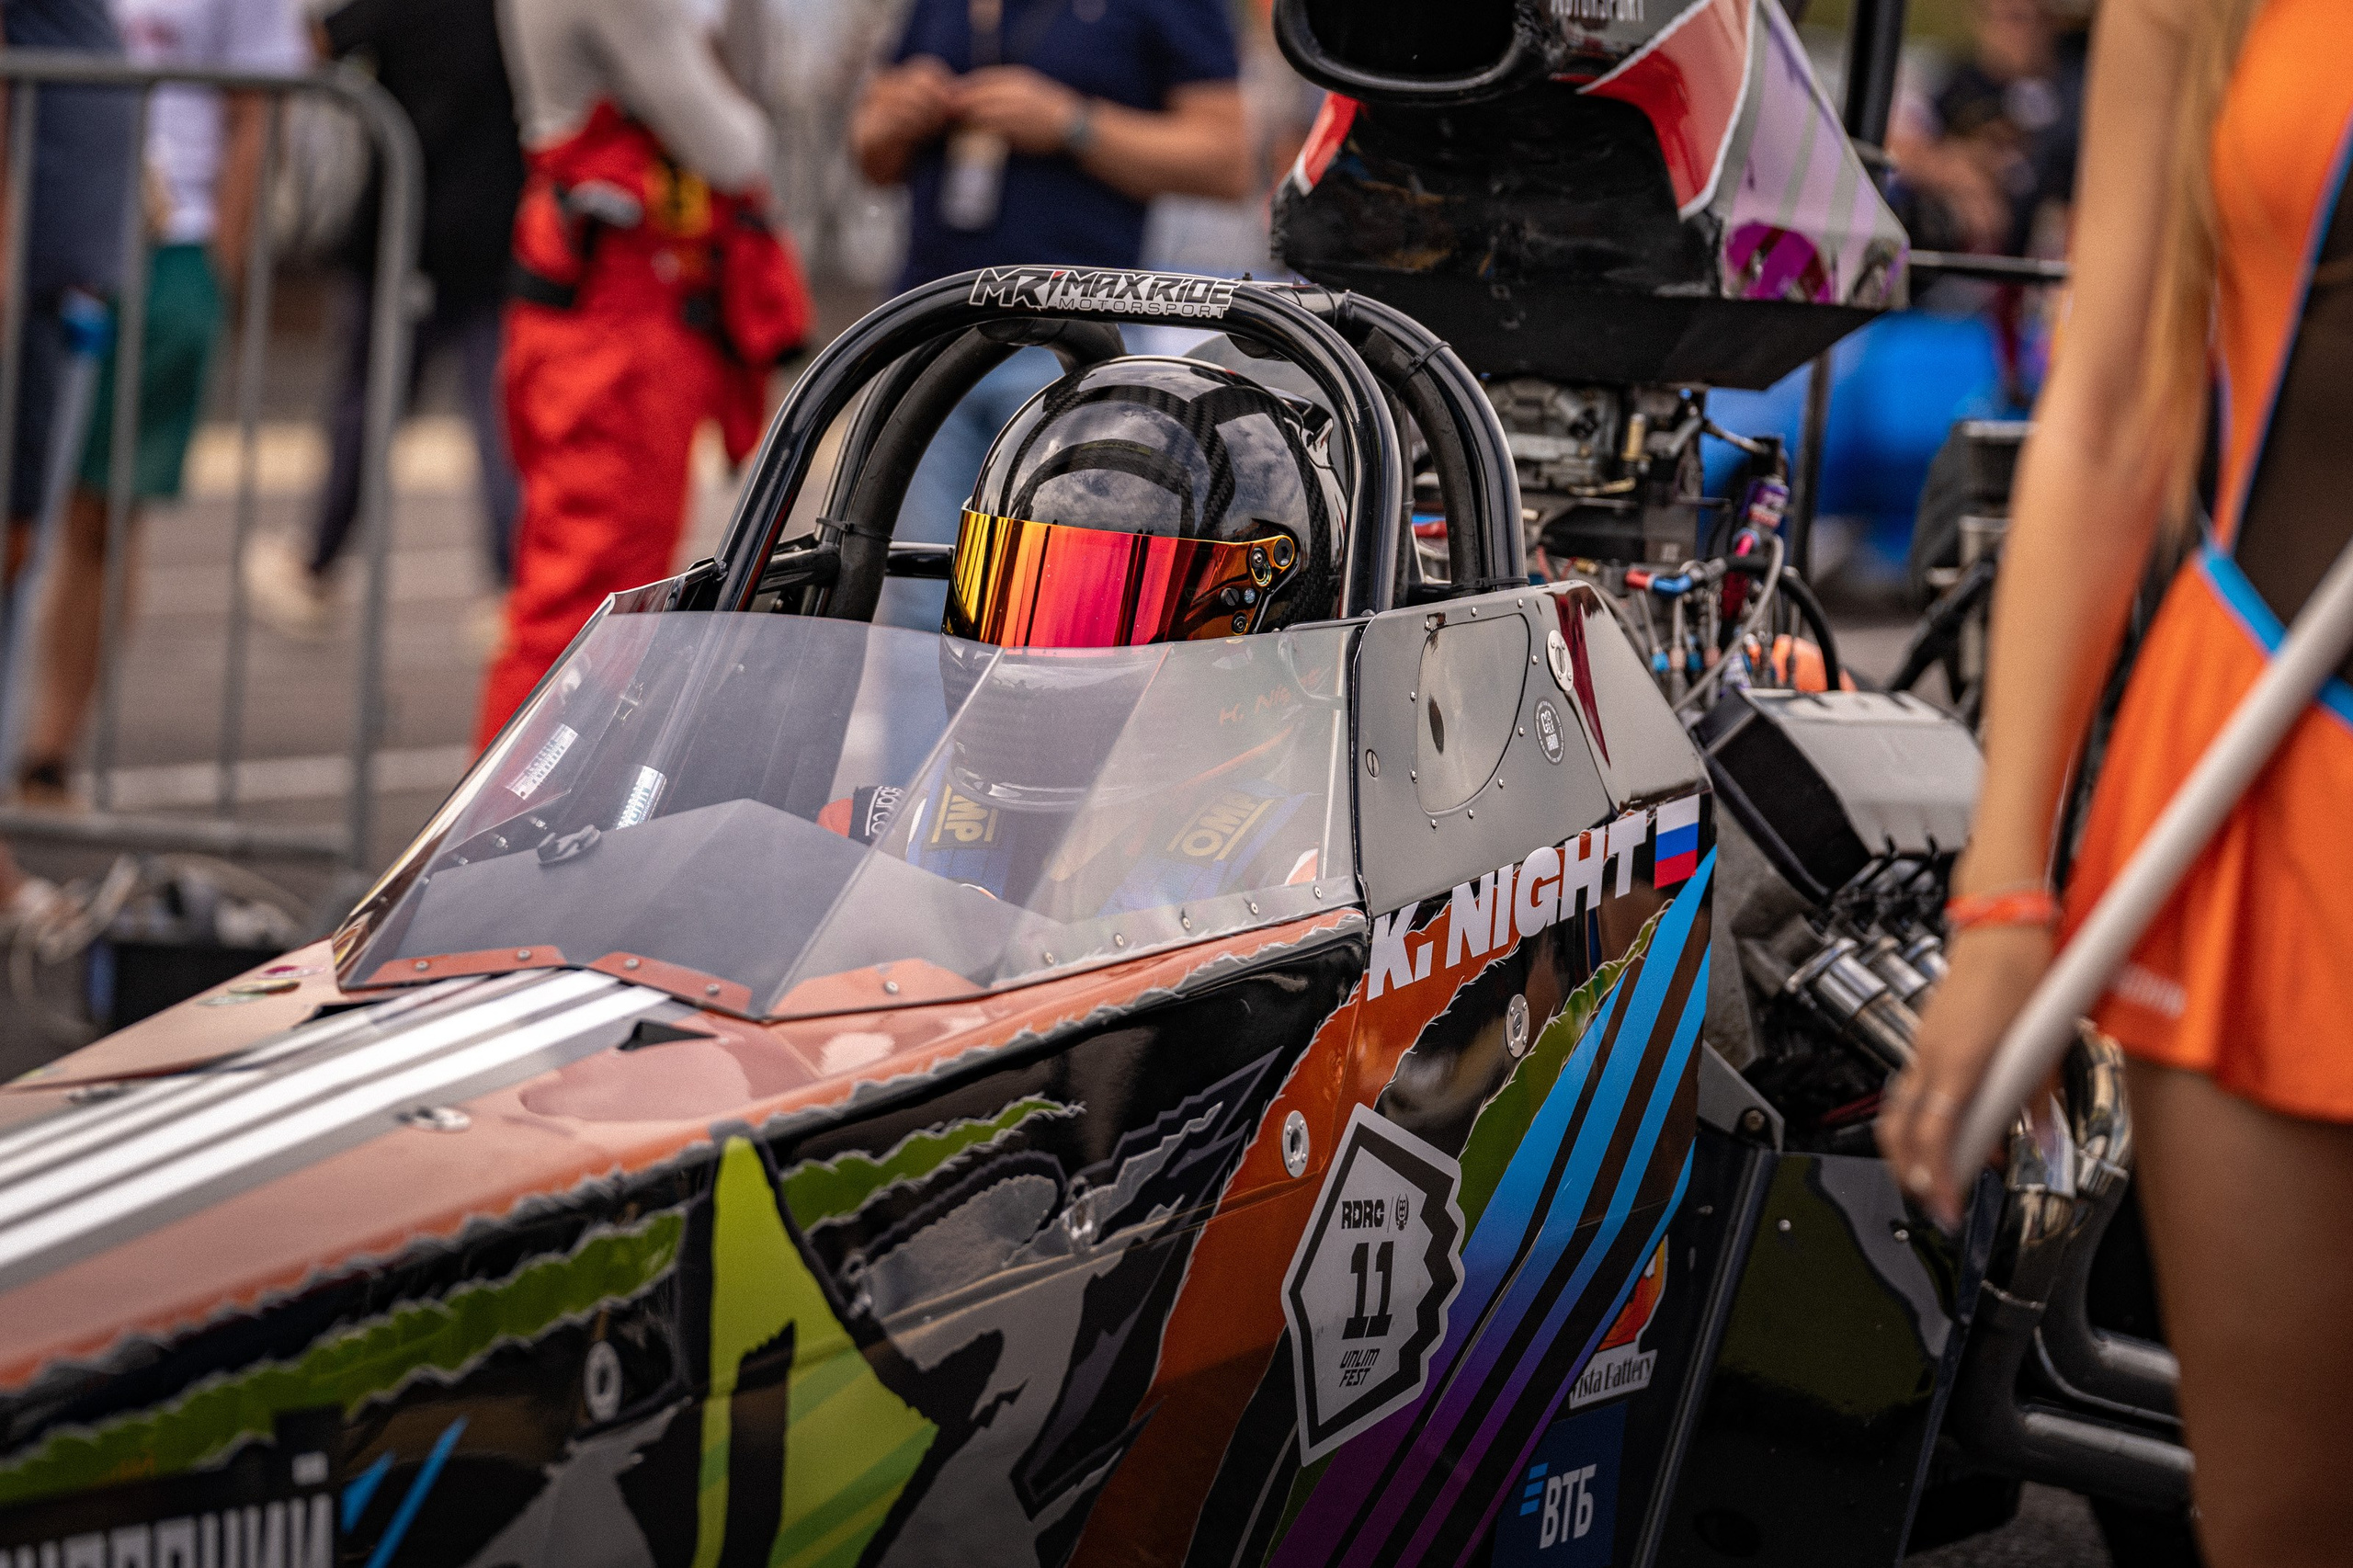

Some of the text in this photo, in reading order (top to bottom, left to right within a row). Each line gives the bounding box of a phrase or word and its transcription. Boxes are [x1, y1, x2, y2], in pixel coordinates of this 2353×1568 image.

[1058, 298, 1235, 318] MOTORSPORT
[944, 795, 989, 843] MP
[1446, 810, 1648, 969] NIGHT
[1342, 1241, 1394, 1340] 11
[1339, 1368, 1371, 1388] FEST
[1340, 1348, 1381, 1369] UNLIM
[1539, 1463, 1597, 1550] ВТБ
